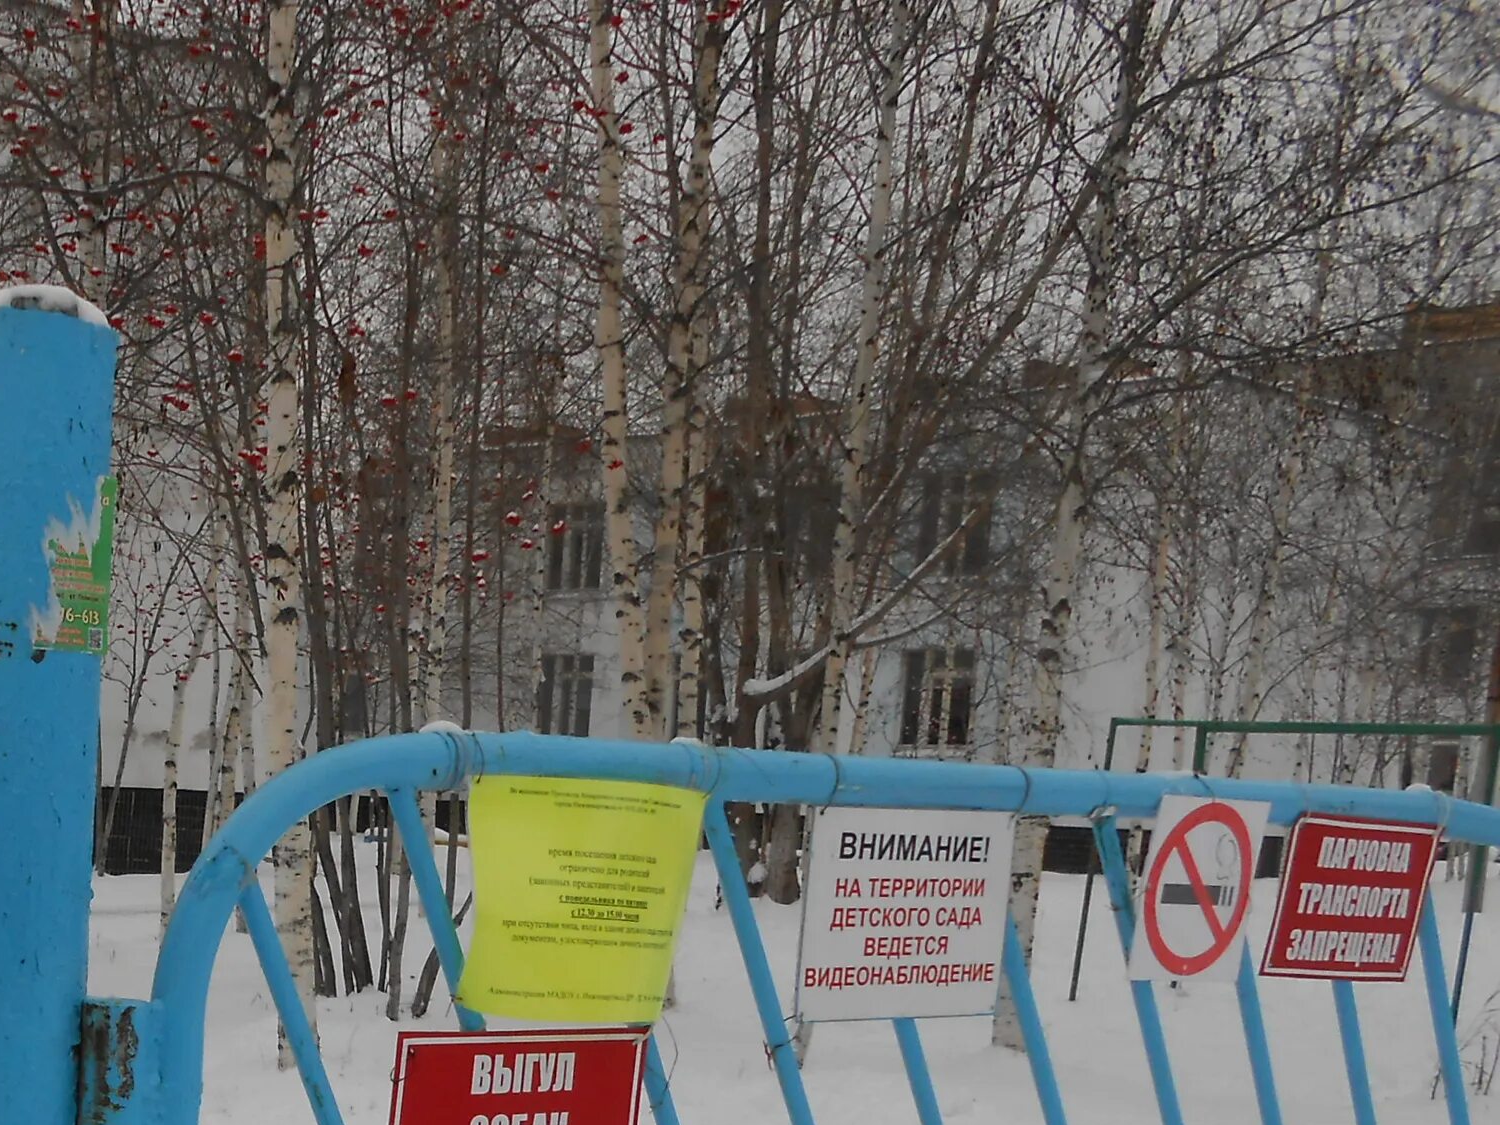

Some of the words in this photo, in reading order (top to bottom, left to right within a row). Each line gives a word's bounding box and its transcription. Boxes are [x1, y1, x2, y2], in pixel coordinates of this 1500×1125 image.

[839, 832, 990, 862] ВНИМАНИЕ!
[1317, 837, 1411, 873] ПАРКОВКА
[835, 878, 861, 897] НА
[869, 878, 985, 897] ТЕРРИТОРИИ
[1298, 883, 1410, 918] ТРАНСПОРТА
[830, 908, 930, 931] ДЕТСКОГО
[936, 907, 981, 929] САДА
[864, 936, 948, 960] ВЕДЕТСЯ
[1286, 929, 1400, 967] ЗАПРЕЩЕНА!
[804, 963, 994, 990] ВИДЕОНАБЛЮДЕНИЕ
[471, 1053, 575, 1094] ВЫГУЛ
